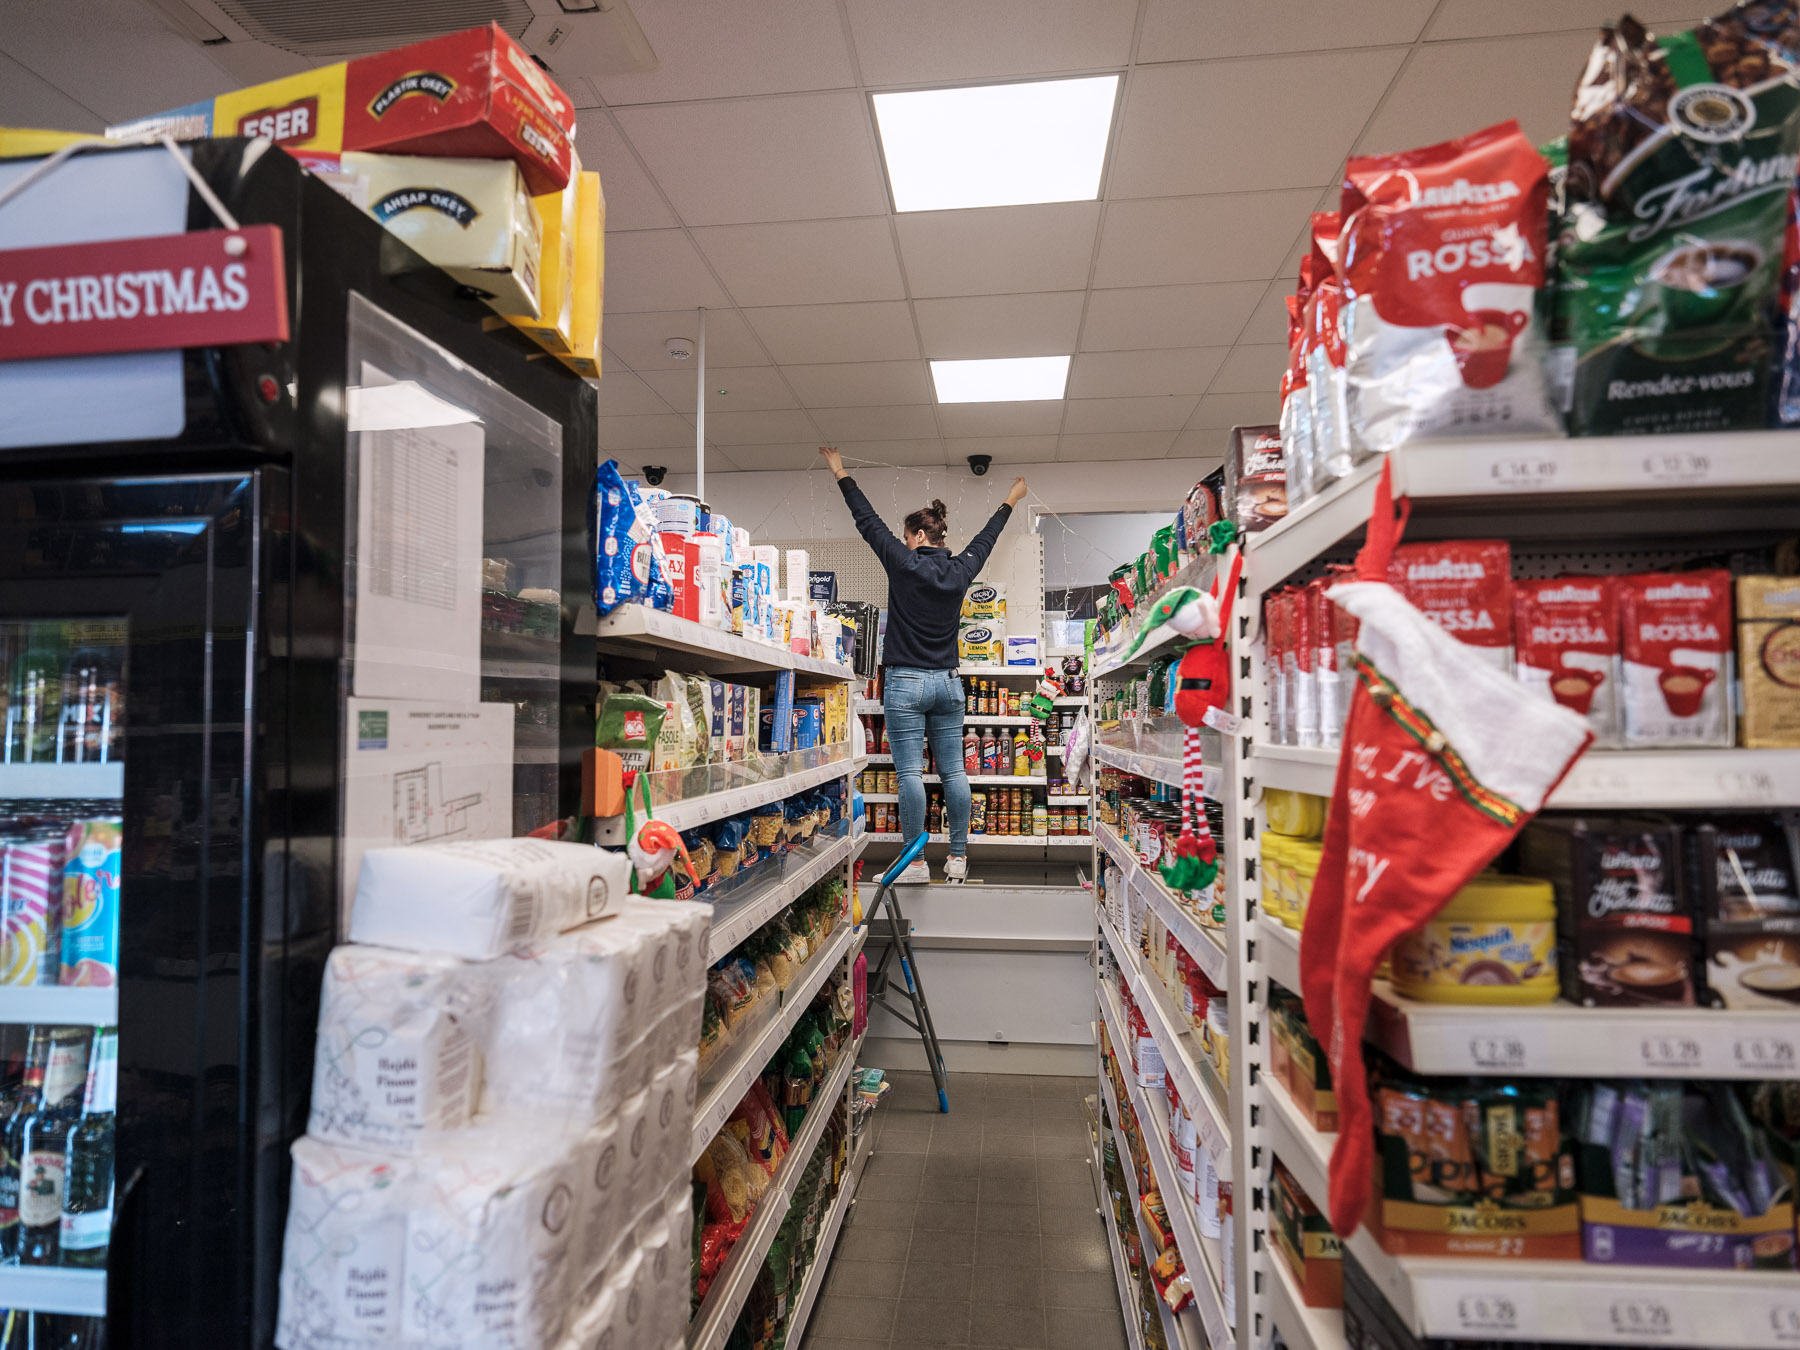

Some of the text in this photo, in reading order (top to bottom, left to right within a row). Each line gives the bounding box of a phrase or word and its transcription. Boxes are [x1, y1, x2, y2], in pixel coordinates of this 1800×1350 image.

[244, 106, 310, 142] ESER
[430, 193, 467, 217] OKEY
[1406, 234, 1537, 281] ROSSA
[24, 262, 250, 325] CHRISTMAS
[808, 575, 832, 585] arigold
[1425, 609, 1495, 631] OSSA
[966, 630, 986, 639] NICKY
[1531, 626, 1608, 644] ROSSA
[1639, 623, 1720, 642] ROSSA
[1381, 748, 1454, 802] I've
[1450, 928, 1513, 953] Nesquik
[1448, 1211, 1527, 1229] JACOBS
[1658, 1211, 1740, 1229] JACOBS
[1320, 1237, 1343, 1252] JAC
